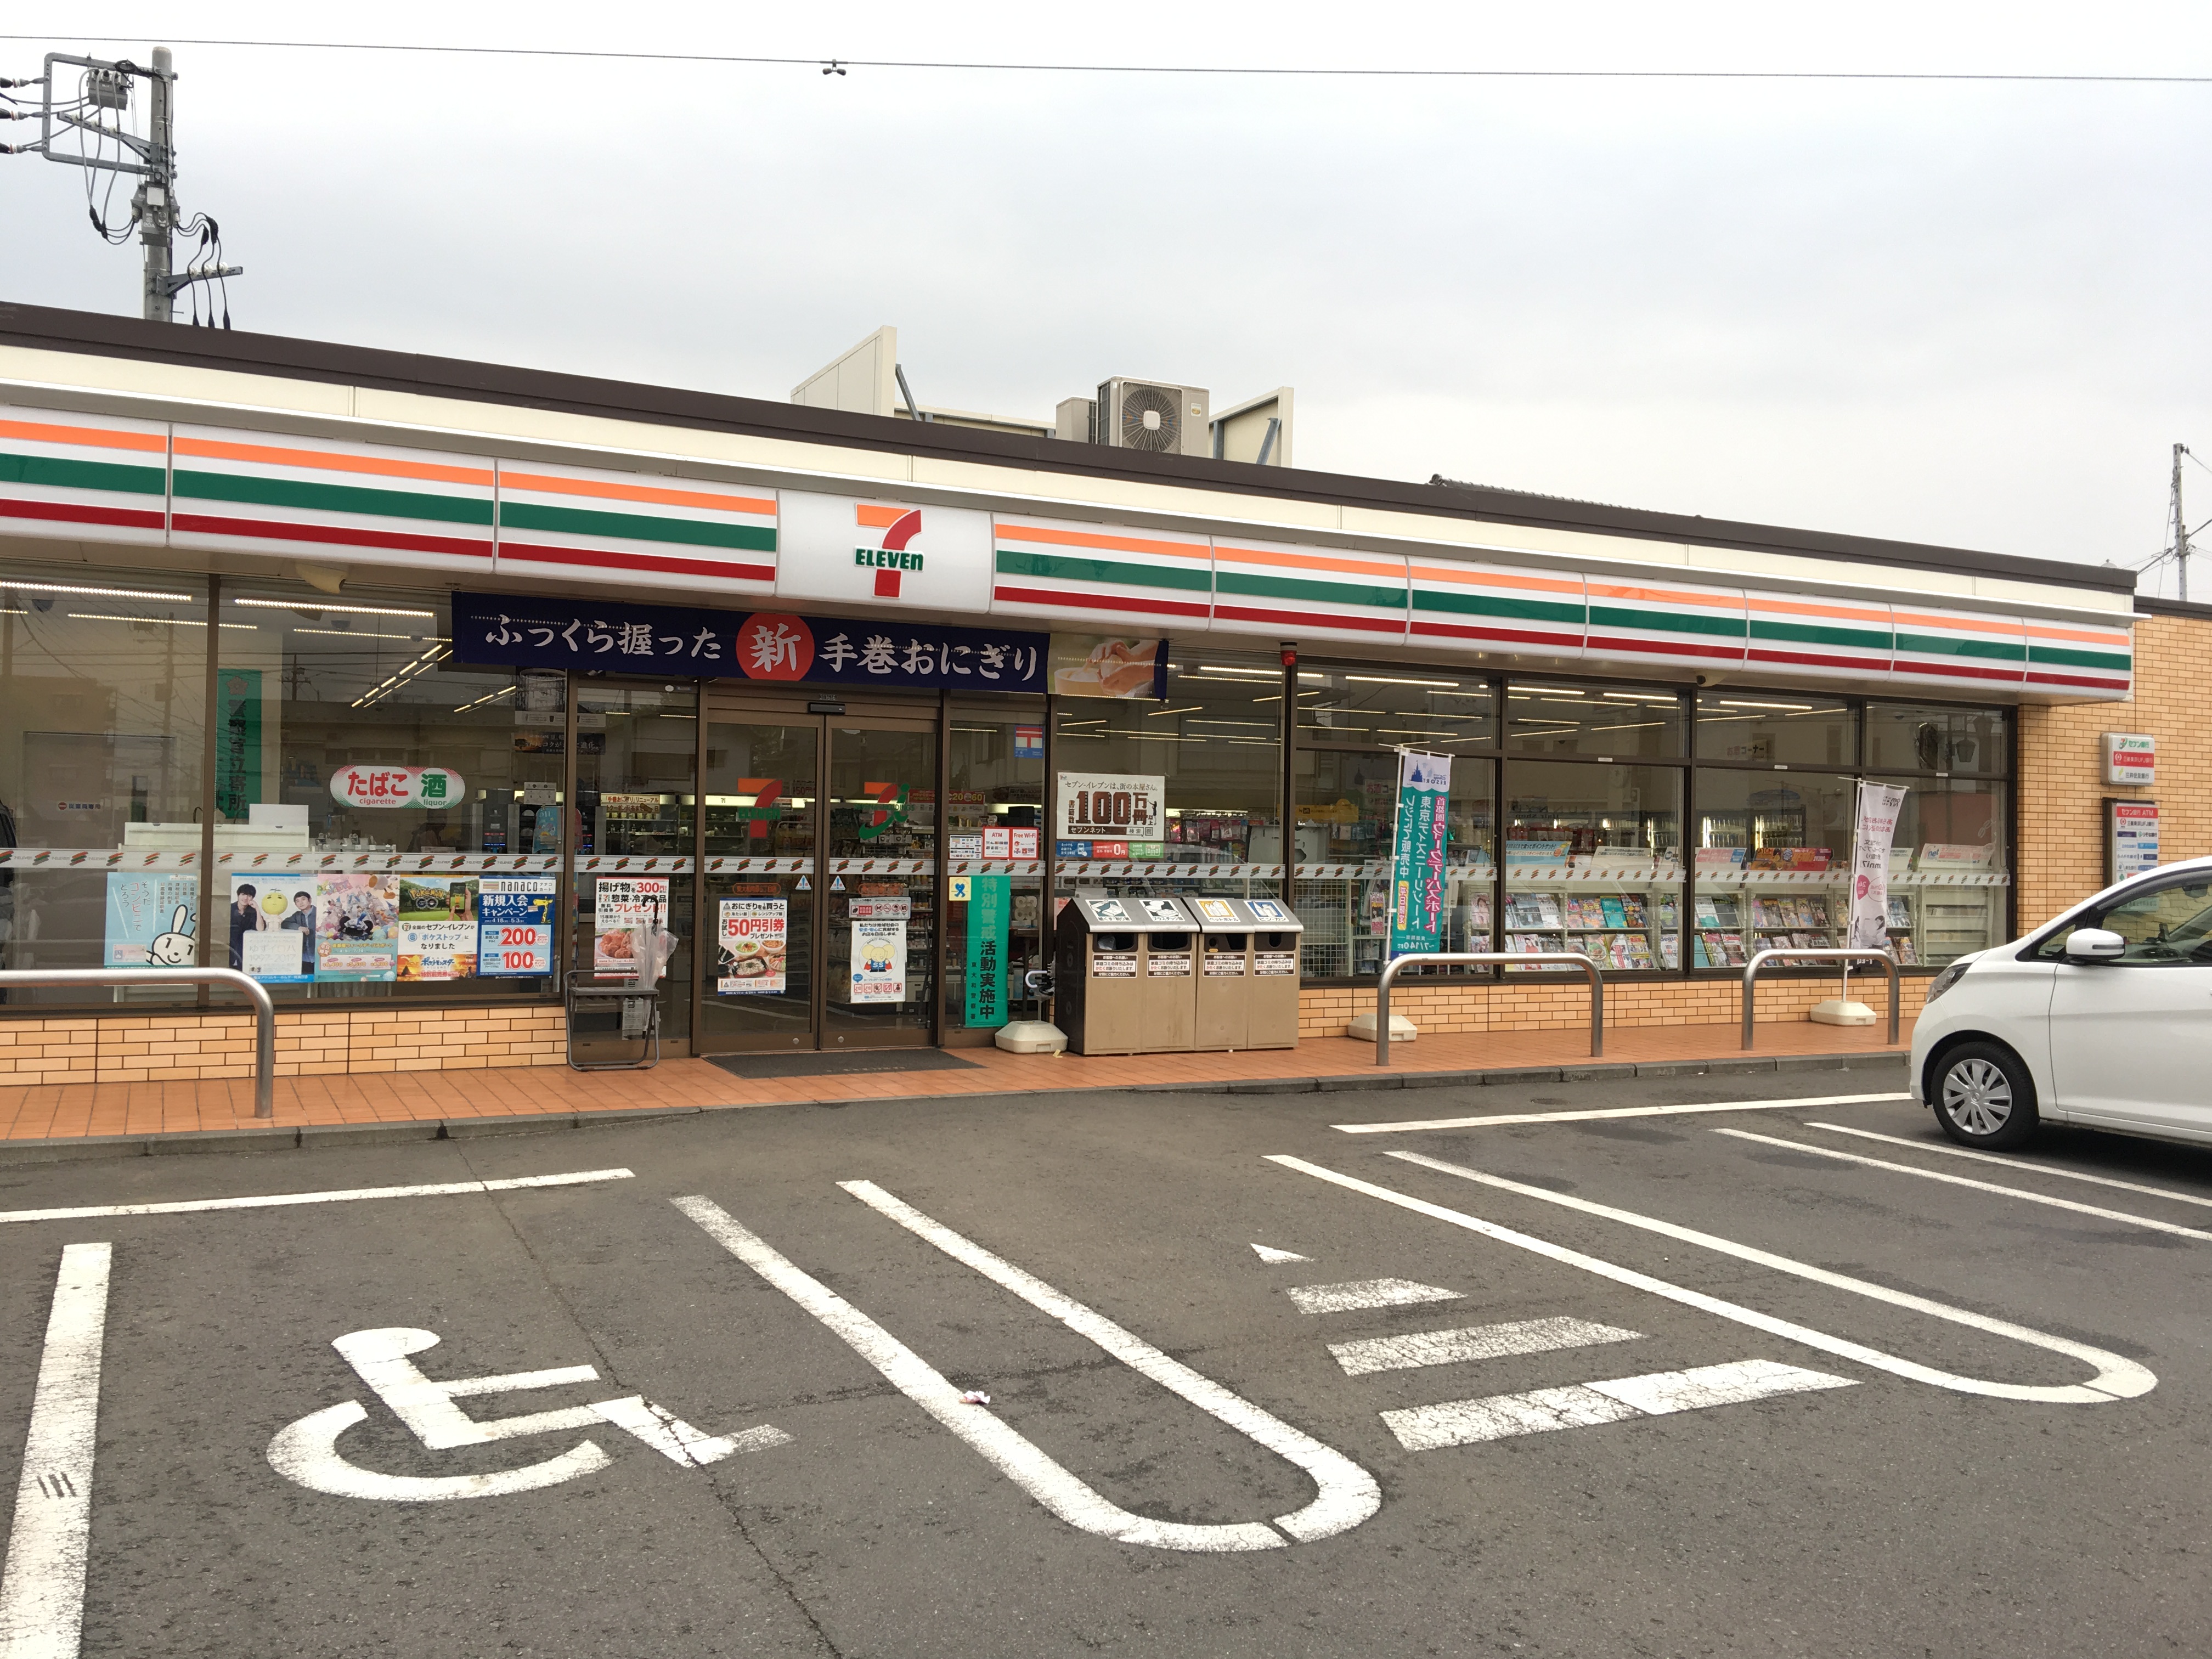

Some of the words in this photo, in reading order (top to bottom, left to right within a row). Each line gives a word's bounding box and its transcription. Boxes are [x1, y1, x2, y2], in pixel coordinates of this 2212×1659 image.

[486, 614, 721, 659] ふっくら握った
[749, 623, 801, 672] 新
[819, 633, 1037, 681] 手巻おにぎり
[347, 771, 409, 797] たばこ
[421, 774, 447, 798] 酒
[142, 881, 151, 906] そうだ
[501, 881, 538, 891] nanaco
[599, 882, 630, 893] 揚げ物
[120, 884, 129, 907] とろう
[482, 895, 528, 906] 新規入会
[130, 883, 143, 931] コンビニで
[482, 907, 527, 916] キャンペーン
[499, 928, 536, 945] 200
[421, 956, 455, 966] ポケットモンスター
[503, 951, 534, 969] 100
